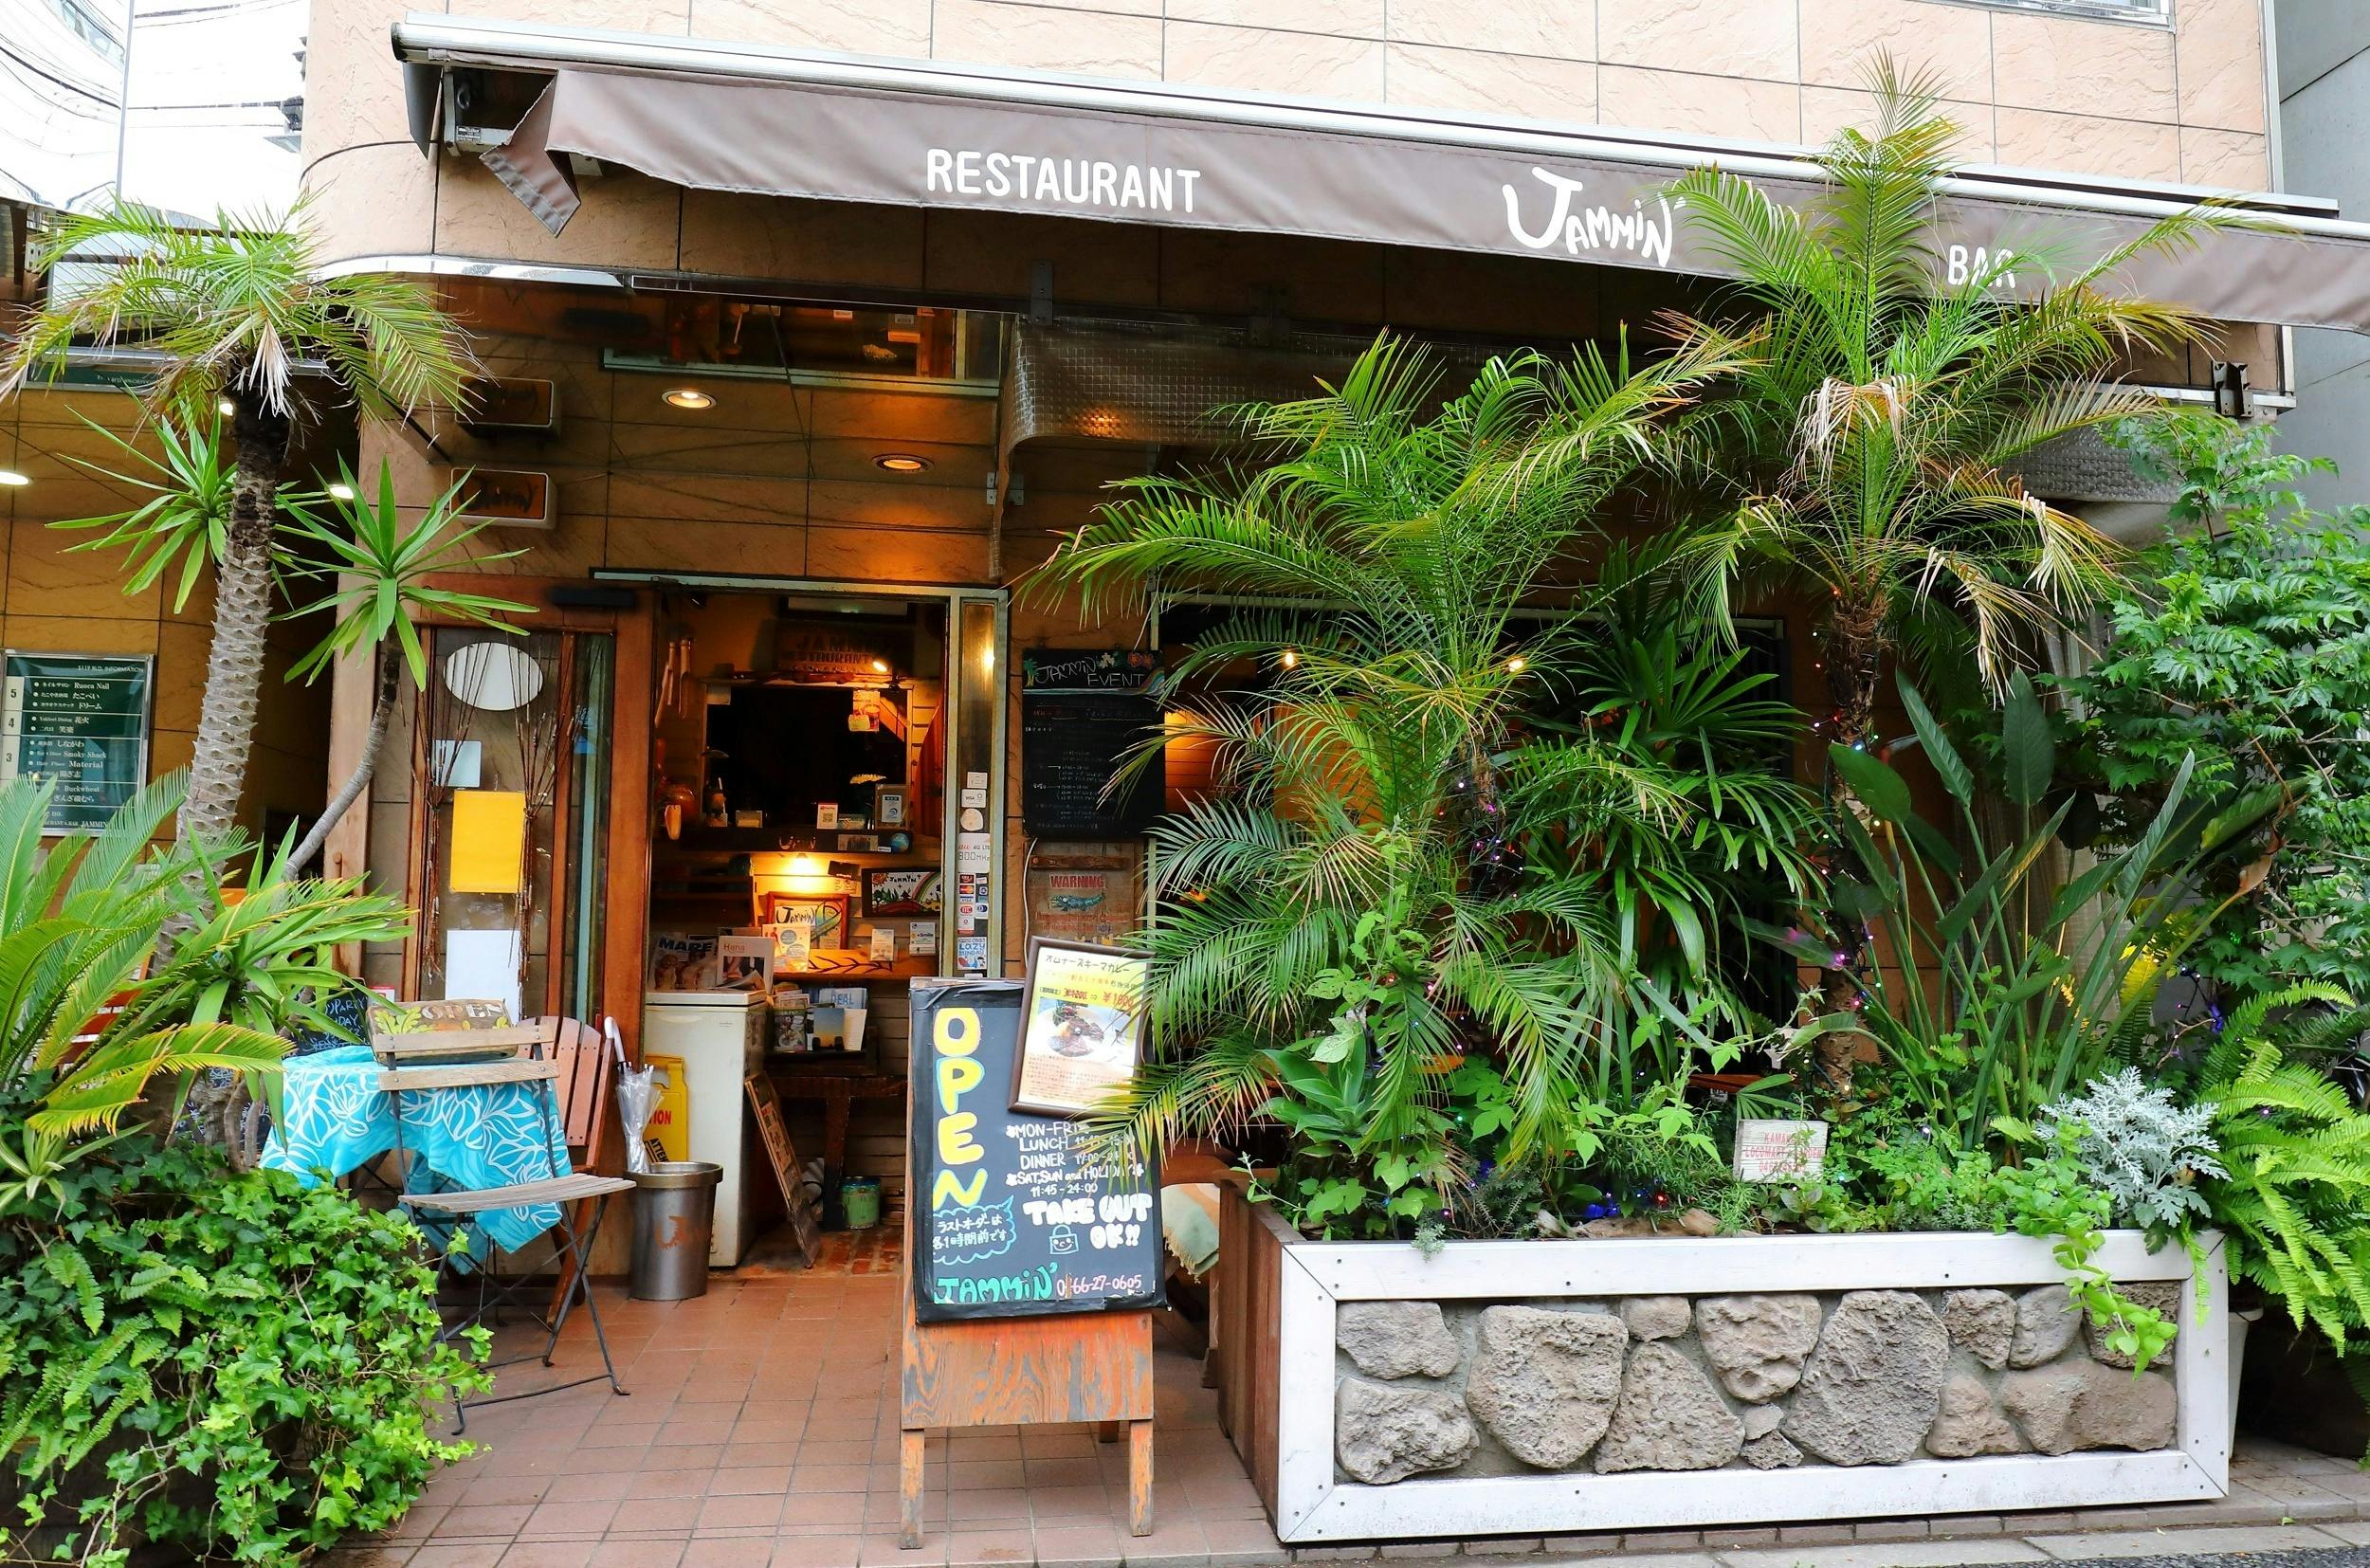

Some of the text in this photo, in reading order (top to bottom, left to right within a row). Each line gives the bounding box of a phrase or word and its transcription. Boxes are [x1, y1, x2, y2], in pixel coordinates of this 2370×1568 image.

[927, 148, 1201, 213] RESTAURANT
[1947, 245, 2016, 288] BAR
[1087, 673, 1145, 687] EVENT
[10, 688, 17, 698] 5
[9, 718, 14, 727] 4
[7, 753, 12, 762] 3
[1049, 874, 1105, 889] WARNING
[422, 1003, 505, 1020] OPEN
[933, 1008, 988, 1210] OPEN
[1019, 1138, 1069, 1152] LUNCH
[1020, 1152, 1066, 1170] DINNER
[1022, 1193, 1153, 1226] TAKE OUT
[937, 1213, 1003, 1233] ラストオーダーは
[1056, 1274, 1142, 1298] 066-27-0605
